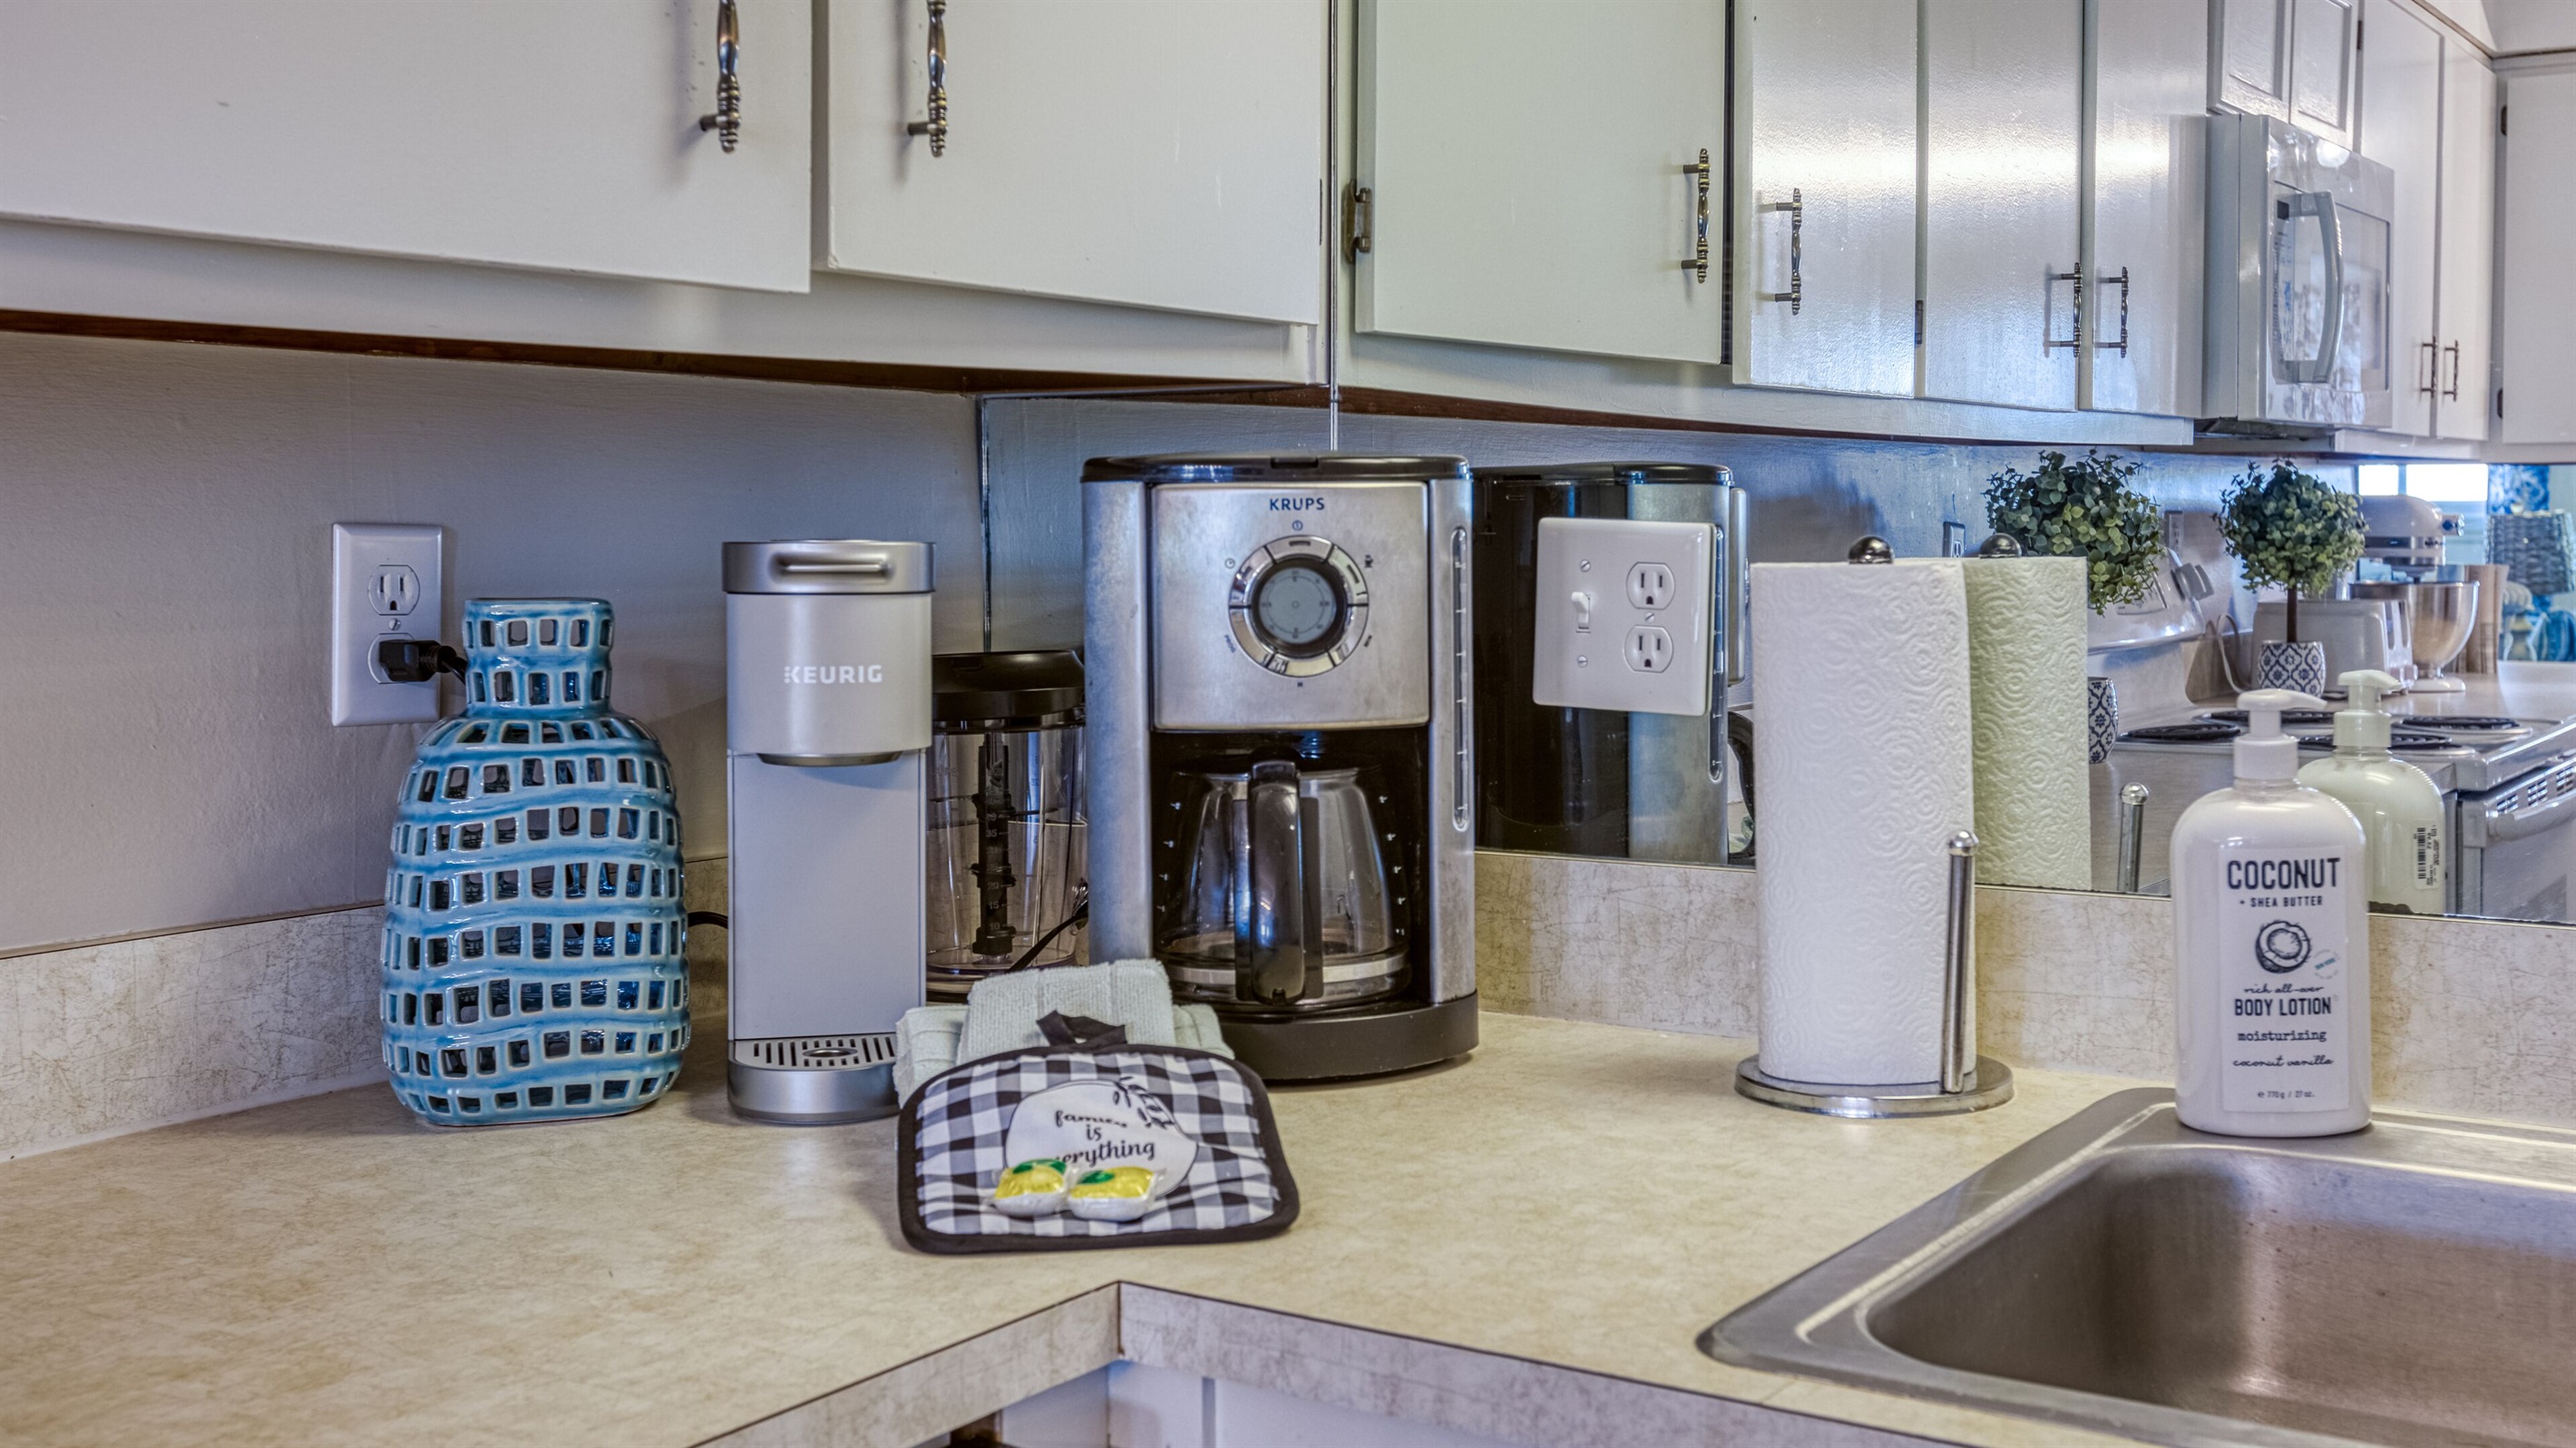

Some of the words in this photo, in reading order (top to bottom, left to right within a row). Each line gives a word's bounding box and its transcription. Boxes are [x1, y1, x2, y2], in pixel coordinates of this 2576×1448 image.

[1269, 497, 1325, 511] KRUPS
[784, 664, 883, 684] KEURIG
[2228, 857, 2340, 890] COCONUT
[2250, 897, 2278, 907] SHEA
[2283, 895, 2322, 907] BUTTER
[2244, 983, 2271, 993] rich
[2275, 983, 2324, 993] all-over
[2235, 998, 2273, 1016] BODY
[2279, 997, 2331, 1016] LOTION
[2238, 1030, 2327, 1042] moisturizing
[2233, 1055, 2284, 1066] coconut
[2287, 1055, 2334, 1066] vanilla
[1086, 1124, 1102, 1141] is
